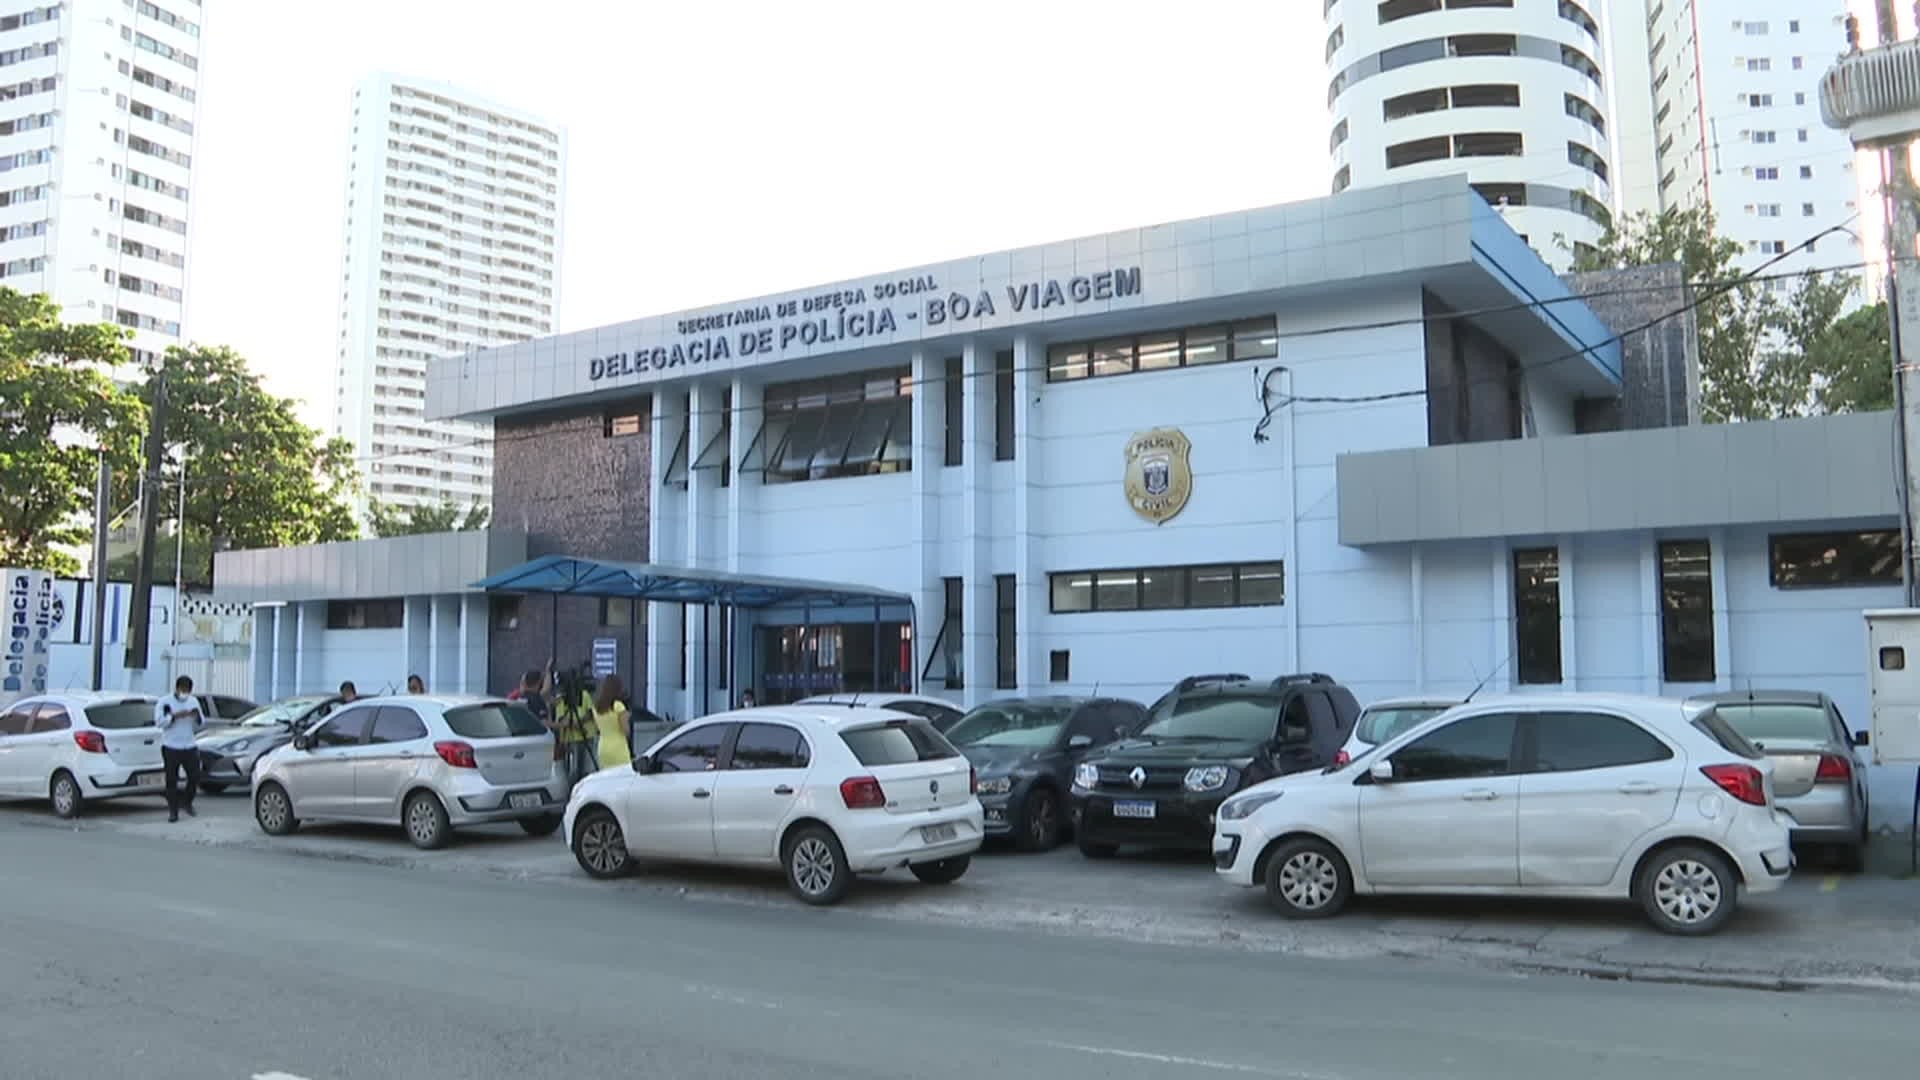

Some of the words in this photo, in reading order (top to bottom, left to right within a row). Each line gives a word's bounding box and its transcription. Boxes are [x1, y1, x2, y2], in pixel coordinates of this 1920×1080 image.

[590, 335, 729, 380] DELEGACIA
[740, 329, 773, 356] DE
[780, 306, 896, 349] POLÍCIA
[1007, 267, 1141, 312] VIAGEM
[678, 309, 771, 334] SECRETARIA
[777, 301, 797, 318] DE
[803, 287, 866, 312] DEFESA
[874, 275, 938, 299] SOCIAL
[4, 575, 29, 691] Delegacia
